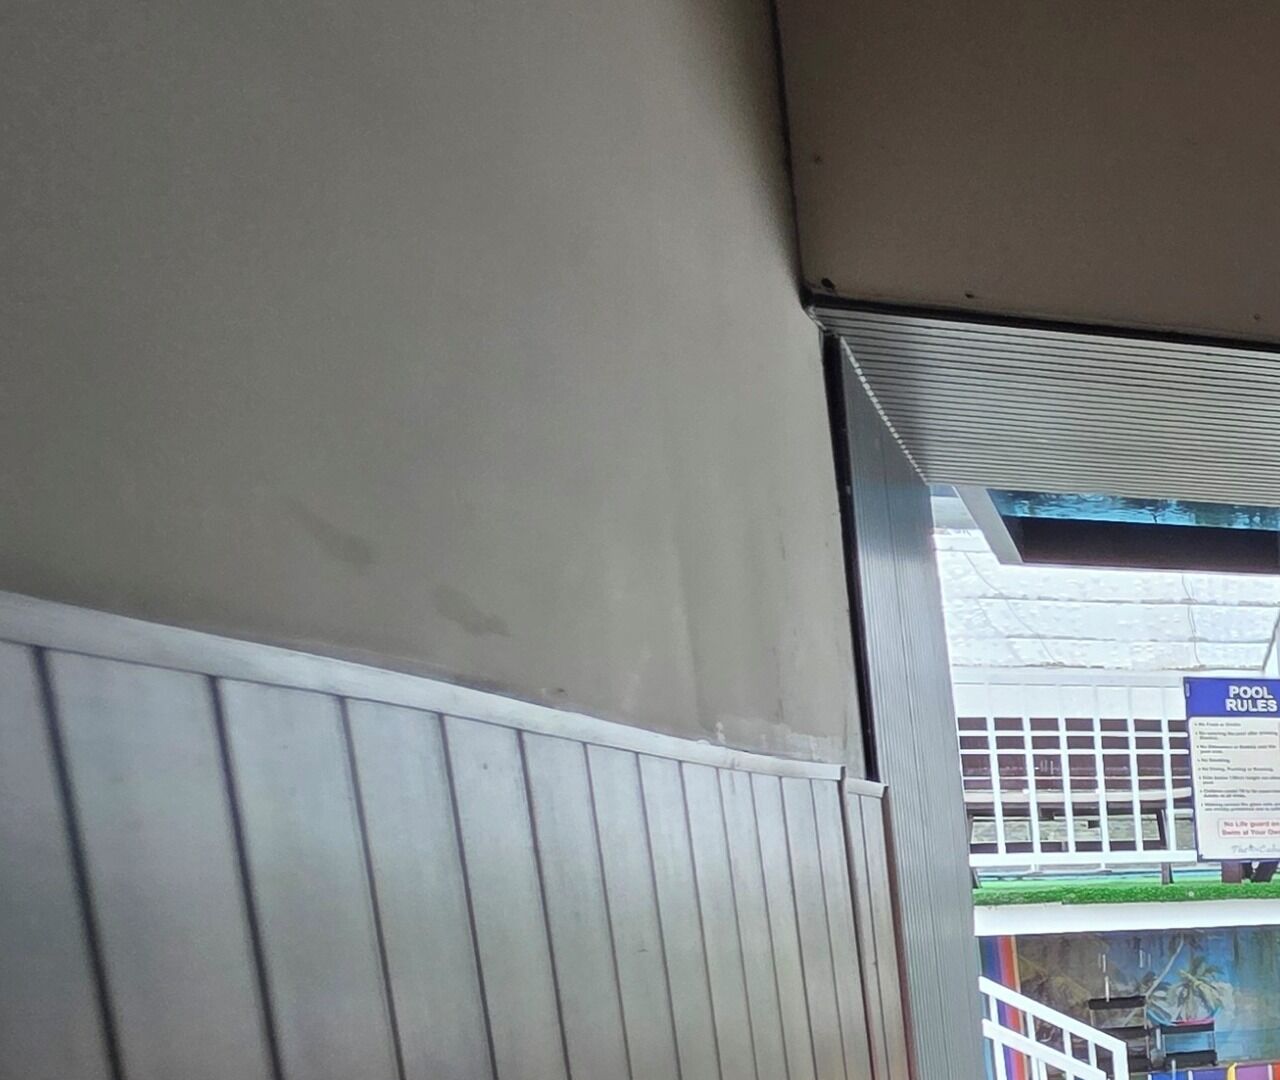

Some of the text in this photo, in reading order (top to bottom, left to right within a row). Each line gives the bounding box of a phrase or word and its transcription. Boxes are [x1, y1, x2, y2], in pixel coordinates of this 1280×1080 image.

[1229, 685, 1274, 699] POOL
[1225, 698, 1278, 712] RULES
[1250, 820, 1270, 828] guard
